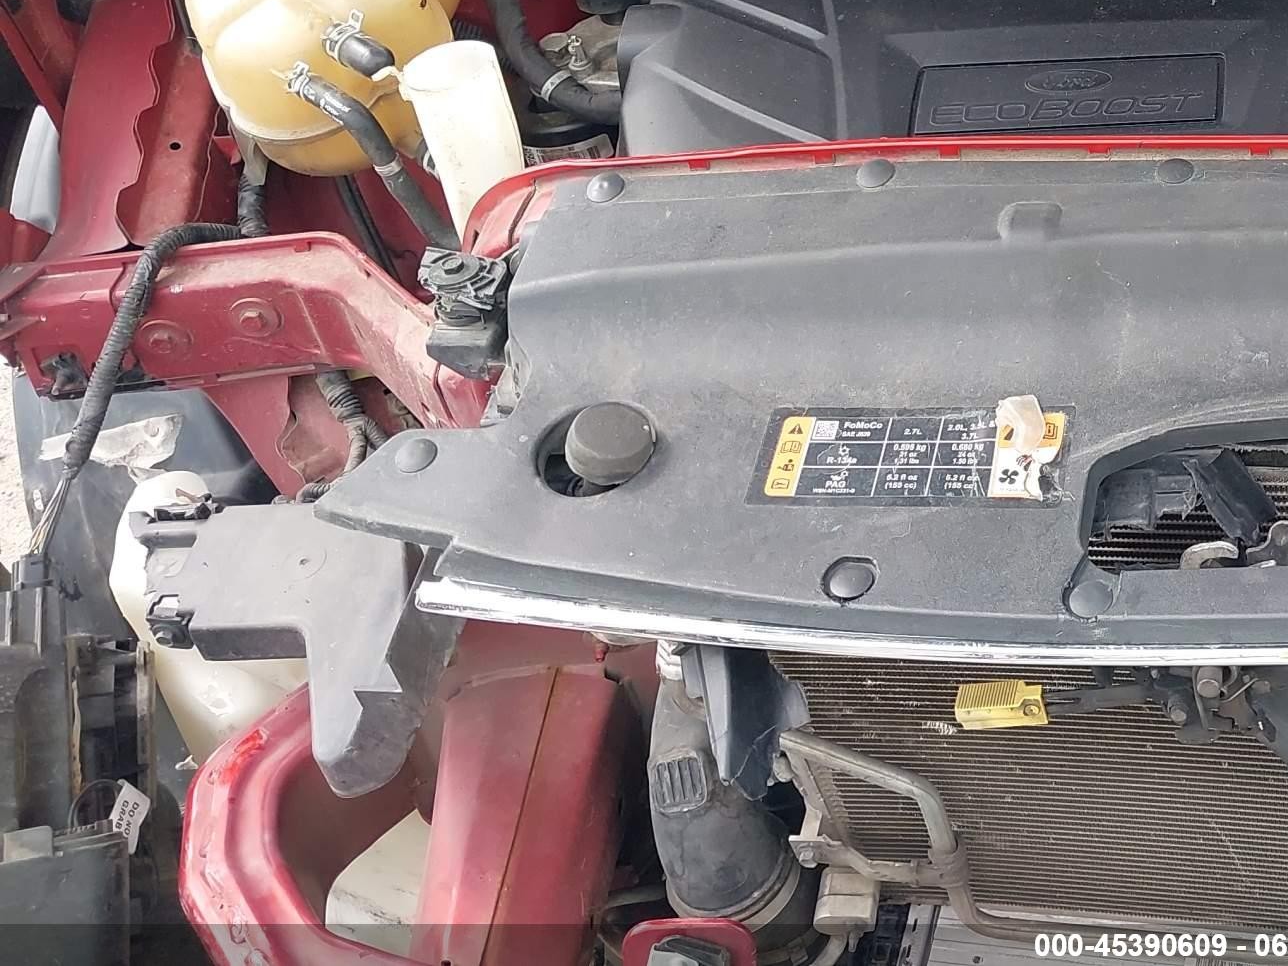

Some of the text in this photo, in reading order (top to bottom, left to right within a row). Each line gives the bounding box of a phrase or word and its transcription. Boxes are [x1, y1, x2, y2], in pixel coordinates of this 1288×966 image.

[843, 421, 884, 430] FoMoCo
[903, 428, 923, 436] 2.7L
[826, 456, 858, 464] R-134a
[115, 800, 129, 830] GRAB
[124, 802, 139, 836] DO NO
